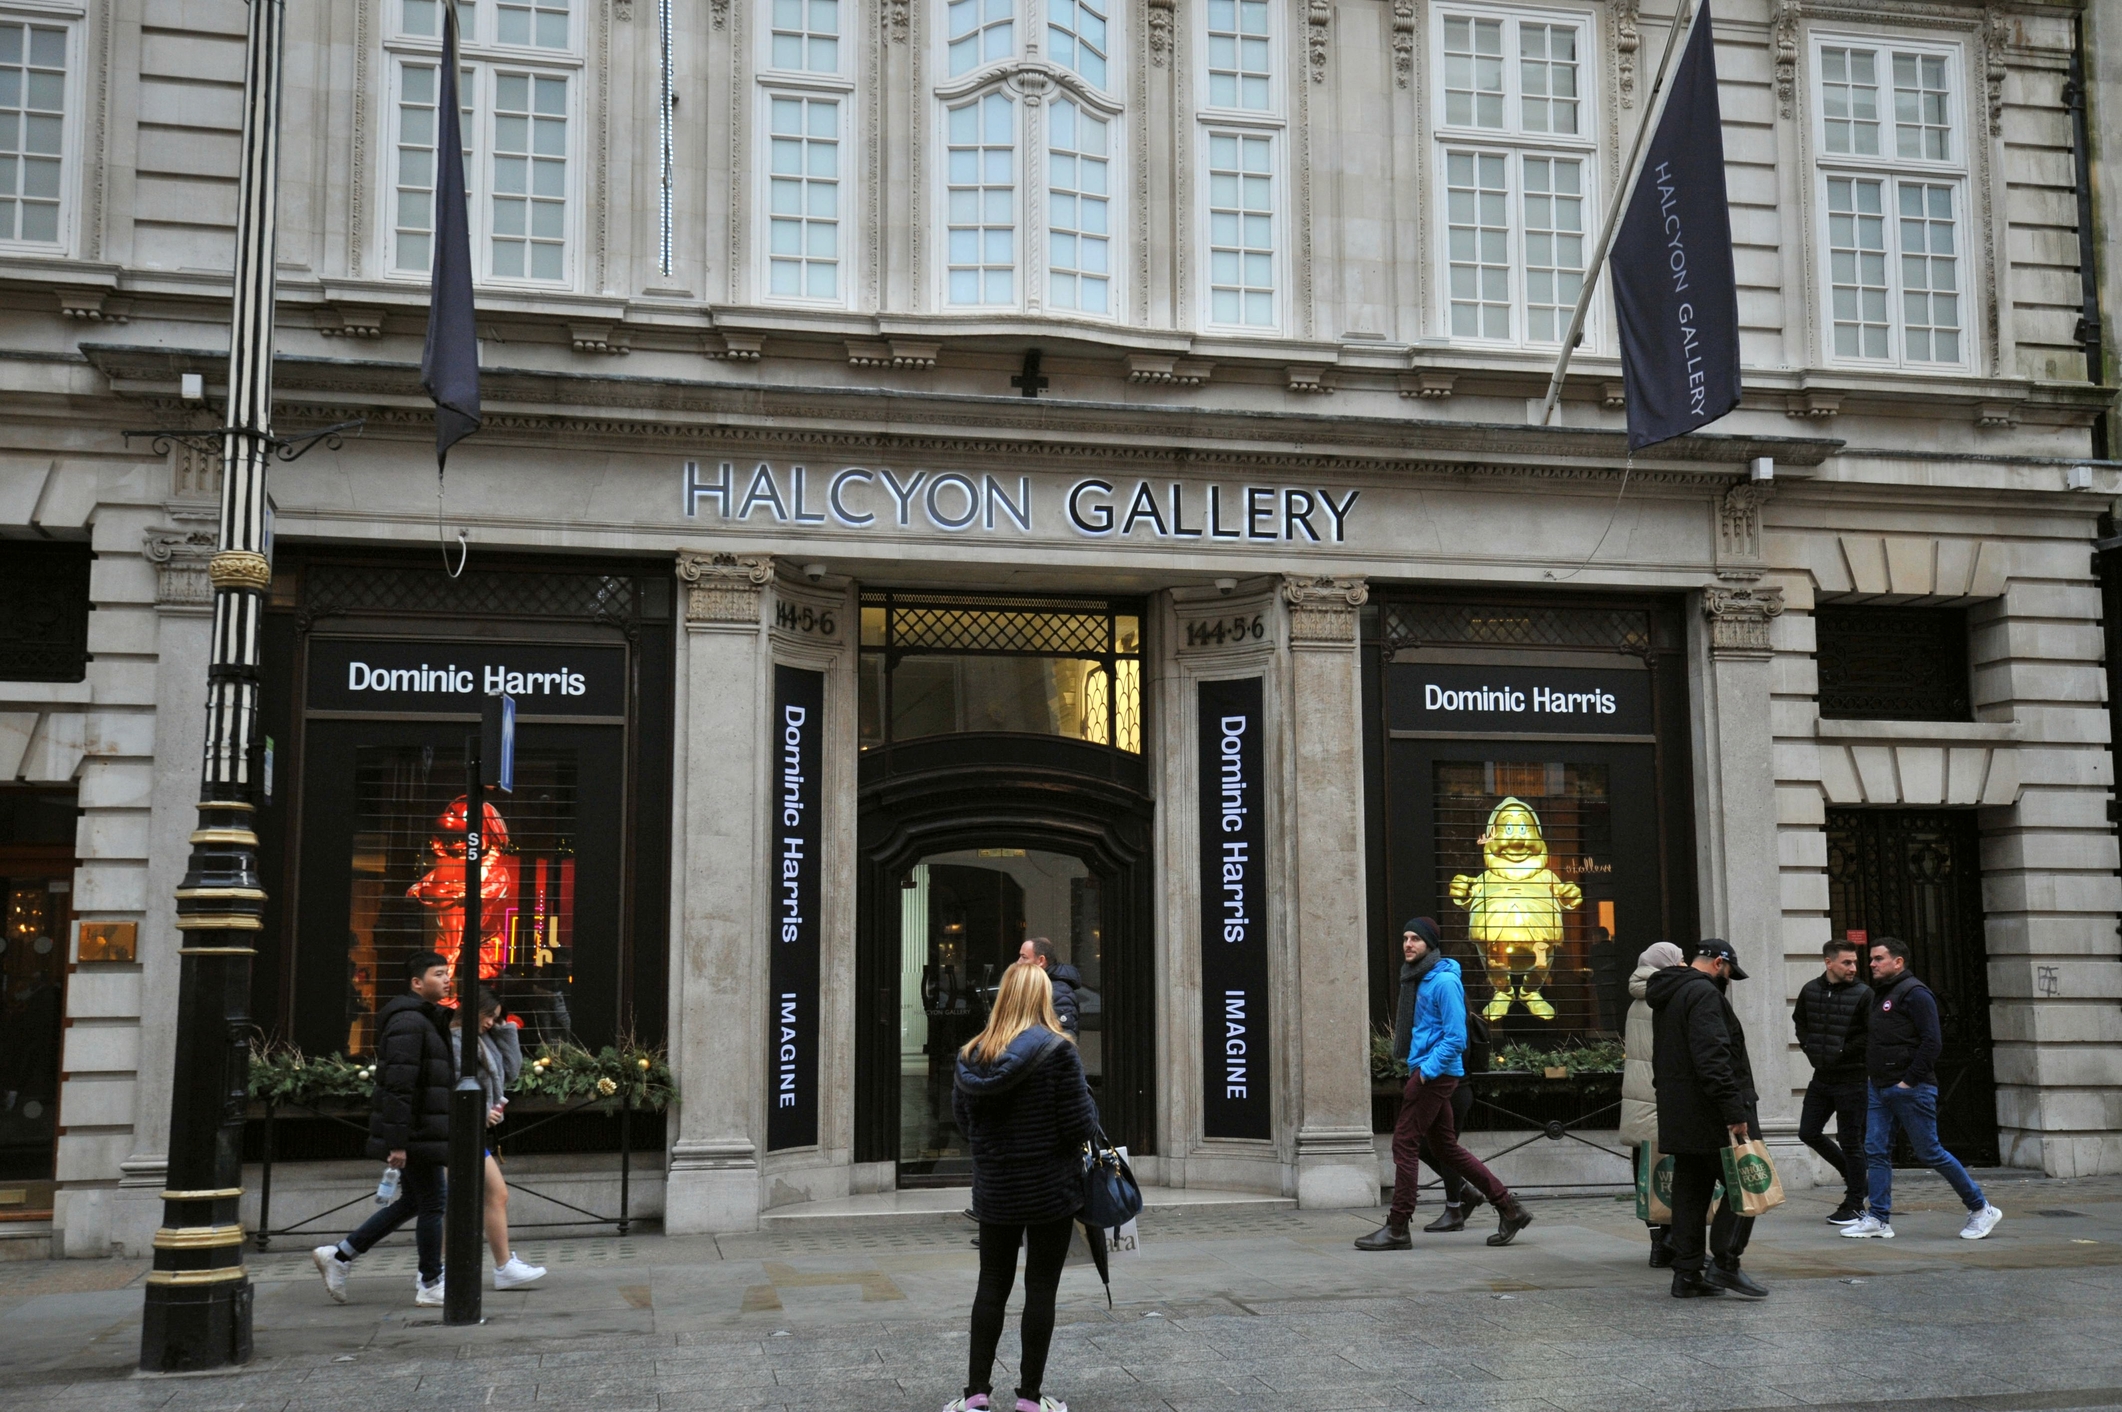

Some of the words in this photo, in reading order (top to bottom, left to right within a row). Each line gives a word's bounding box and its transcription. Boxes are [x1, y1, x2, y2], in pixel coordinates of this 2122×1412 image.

[1655, 161, 1689, 293] HALCYON
[1679, 303, 1705, 416] GALLERY
[685, 460, 1031, 532] HALCYON
[1066, 479, 1361, 542] GALLERY
[349, 662, 473, 693] Dominic
[484, 665, 586, 696] Harris
[1425, 684, 1525, 712] Dominic
[1533, 686, 1616, 714] Harris
[784, 705, 805, 826] Dominic
[1222, 715, 1248, 831] Dominic
[783, 837, 803, 942] Harris
[1223, 842, 1250, 943] Harris
[779, 993, 796, 1108] IMAGINE
[1225, 990, 1247, 1099] IMAGINE
